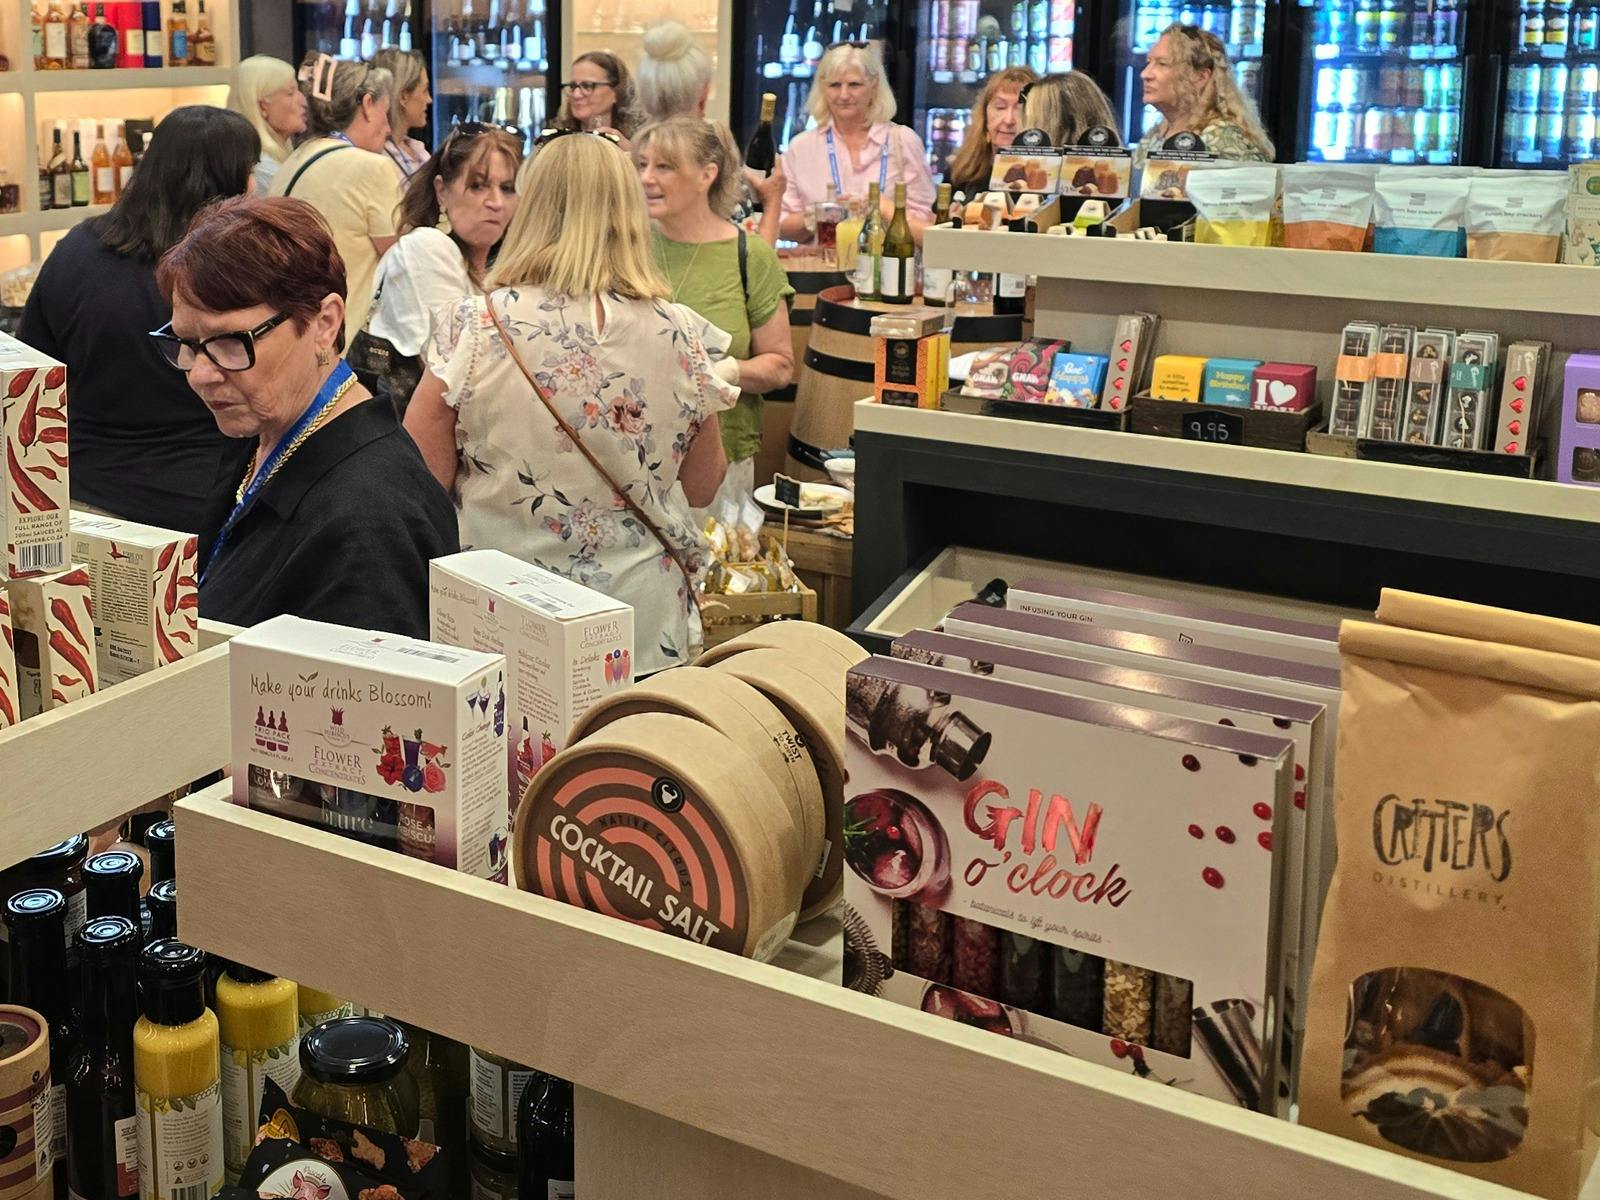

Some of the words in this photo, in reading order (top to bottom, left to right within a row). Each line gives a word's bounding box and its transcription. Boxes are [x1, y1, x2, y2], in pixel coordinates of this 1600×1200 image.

[1255, 378, 1269, 405] I
[1191, 421, 1229, 441] 9.95
[1019, 604, 1055, 616] INFUSING
[1056, 610, 1077, 621] YOUR
[583, 621, 619, 638] FLOWER
[250, 671, 282, 696] Make
[289, 683, 316, 701] your
[322, 676, 362, 702] drinks
[368, 681, 432, 709] Blossom!
[255, 725, 271, 735] TRIO
[272, 730, 291, 741] PACK
[782, 730, 803, 760] TWIST
[314, 745, 362, 769] FLOWER
[963, 779, 1104, 866] GIN
[1372, 793, 1512, 883] CRITTERS
[549, 814, 655, 908] COCKTAIL
[657, 894, 720, 947] SALT
[963, 850, 1132, 908] o'clock
